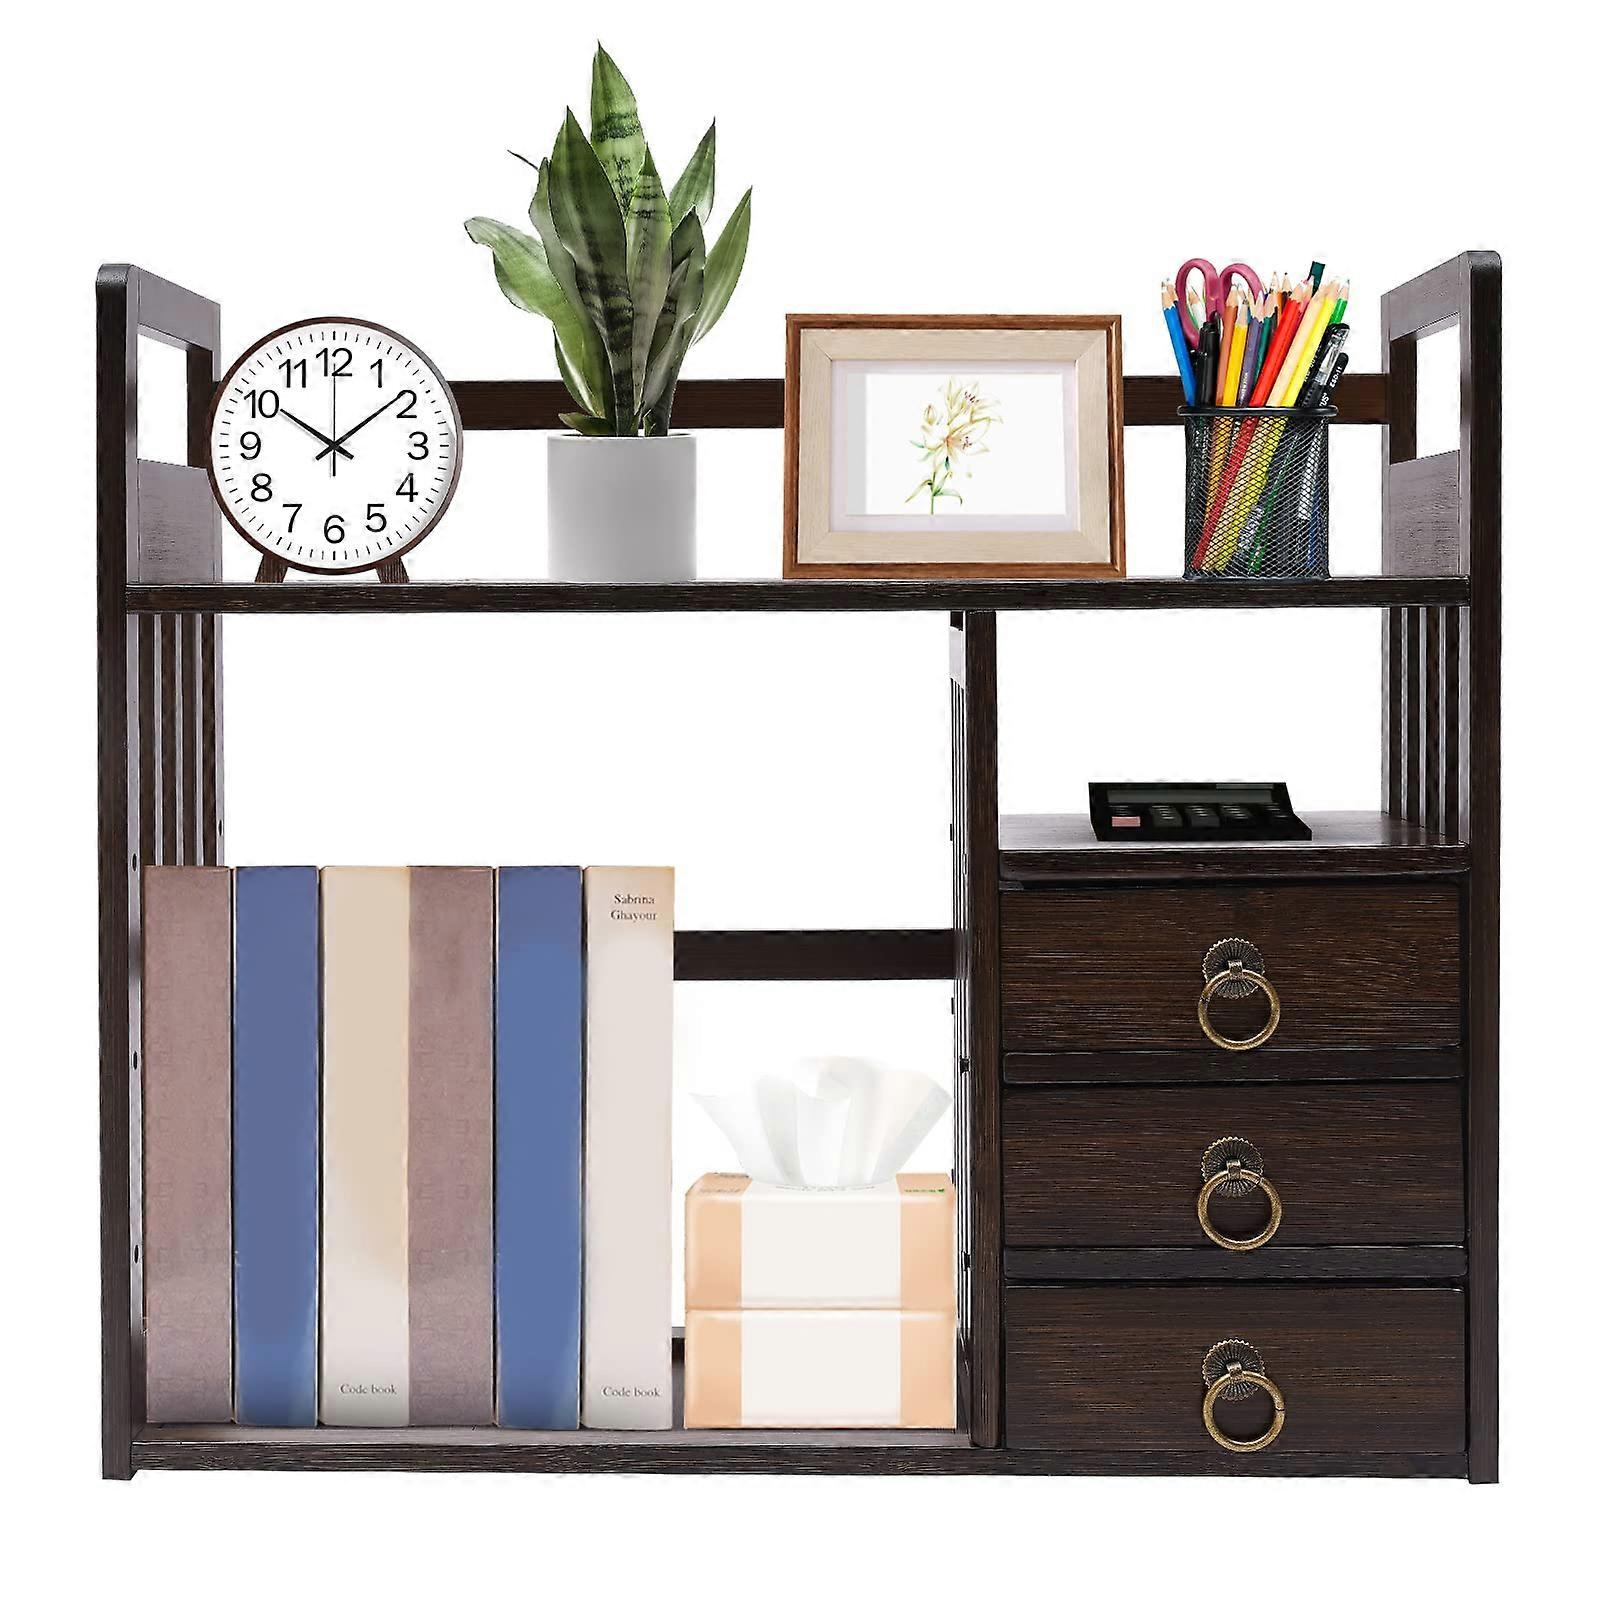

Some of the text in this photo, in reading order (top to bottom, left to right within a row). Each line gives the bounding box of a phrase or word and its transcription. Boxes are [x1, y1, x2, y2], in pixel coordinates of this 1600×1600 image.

[278, 358, 307, 389] 11
[315, 347, 353, 377] 12
[370, 358, 383, 389] 1
[243, 389, 280, 419] 10
[396, 389, 418, 419] 2
[239, 431, 262, 461] 9
[407, 431, 429, 461] 3
[250, 472, 273, 503] 8
[395, 472, 419, 503] 4
[282, 503, 303, 533] 7
[323, 514, 345, 544] 6
[365, 503, 387, 533] 5
[614, 893, 655, 904] Sabrina
[610, 909, 657, 923] Ghayour
[340, 1383, 398, 1395] Code book
[602, 1386, 661, 1398] Code book
